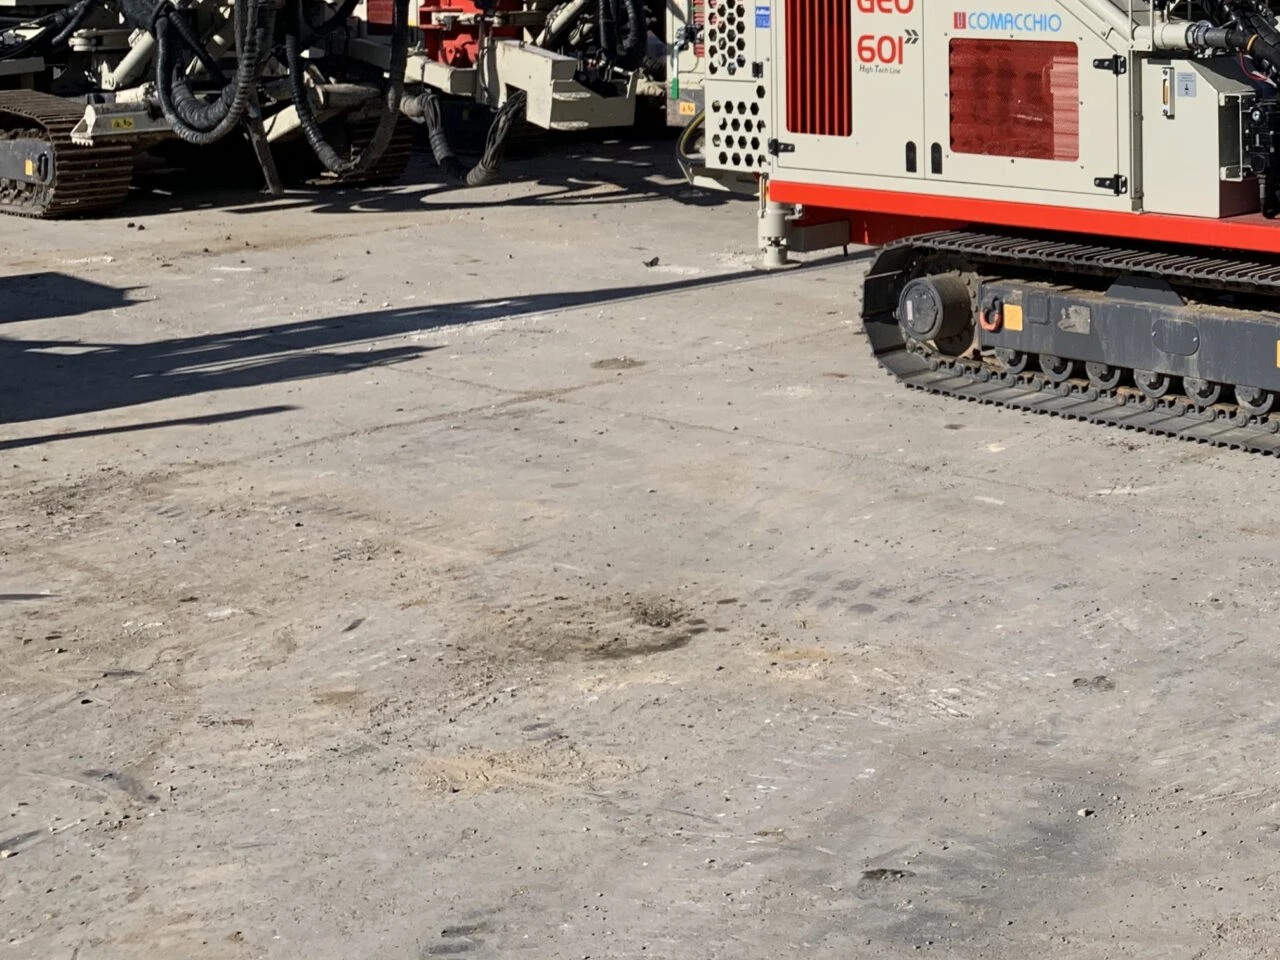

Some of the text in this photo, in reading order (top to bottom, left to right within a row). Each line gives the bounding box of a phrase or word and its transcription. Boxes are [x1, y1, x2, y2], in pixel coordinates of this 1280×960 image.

[968, 12, 1062, 32] COMACCHIO
[858, 35, 903, 65] 601
[859, 64, 873, 74] High
[875, 65, 888, 73] Tech
